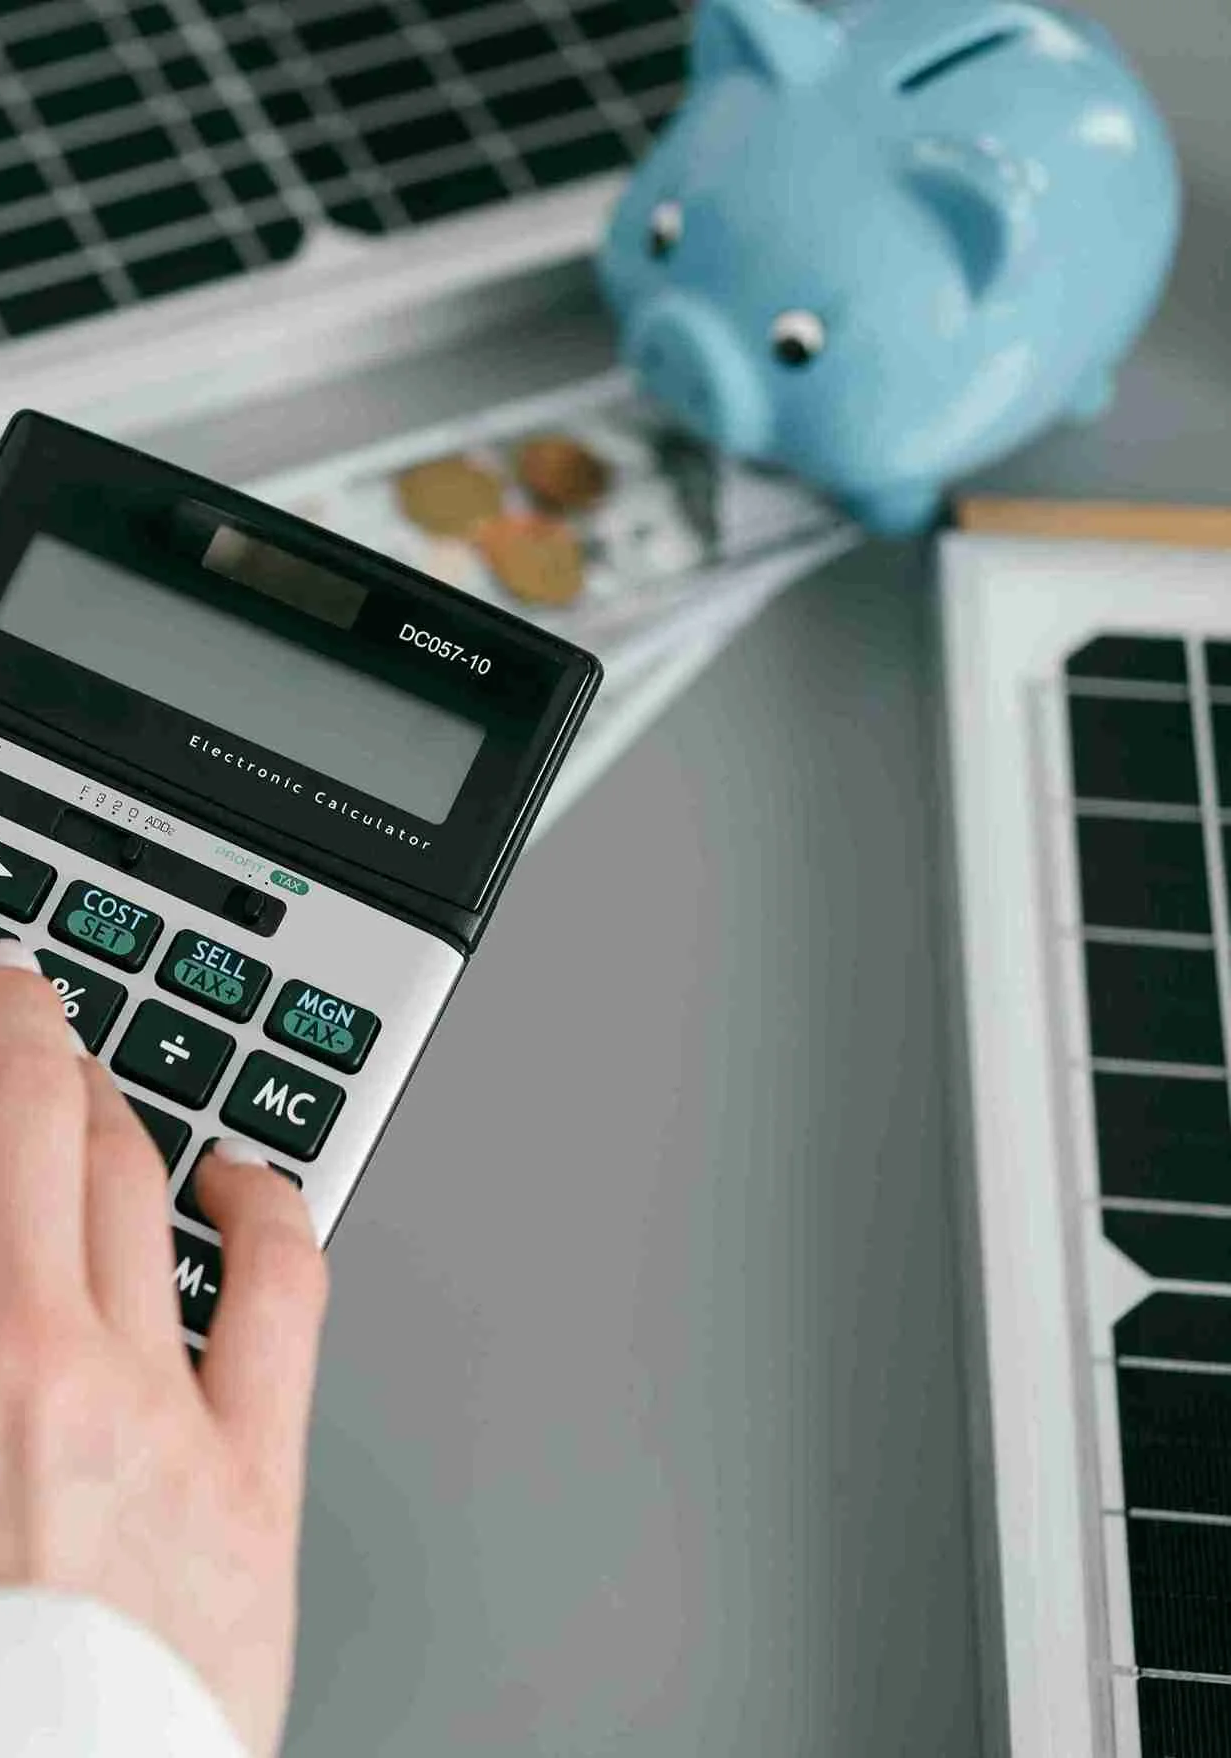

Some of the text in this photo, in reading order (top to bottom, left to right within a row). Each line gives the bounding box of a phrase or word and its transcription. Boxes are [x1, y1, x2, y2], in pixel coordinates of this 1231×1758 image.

[398, 623, 492, 675] DC057-10
[80, 784, 90, 794] F
[113, 800, 123, 811] 2
[189, 734, 433, 850] Electronic Calculator
[215, 847, 266, 873] PROFIT
[83, 889, 148, 930] COST
[79, 916, 125, 949] SET
[181, 962, 236, 999] TAX+
[192, 940, 246, 981] SELL
[296, 989, 356, 1029] MGN
[292, 1012, 345, 1049] TAX-
[252, 1077, 317, 1126] MC
[174, 1256, 217, 1298] M-
